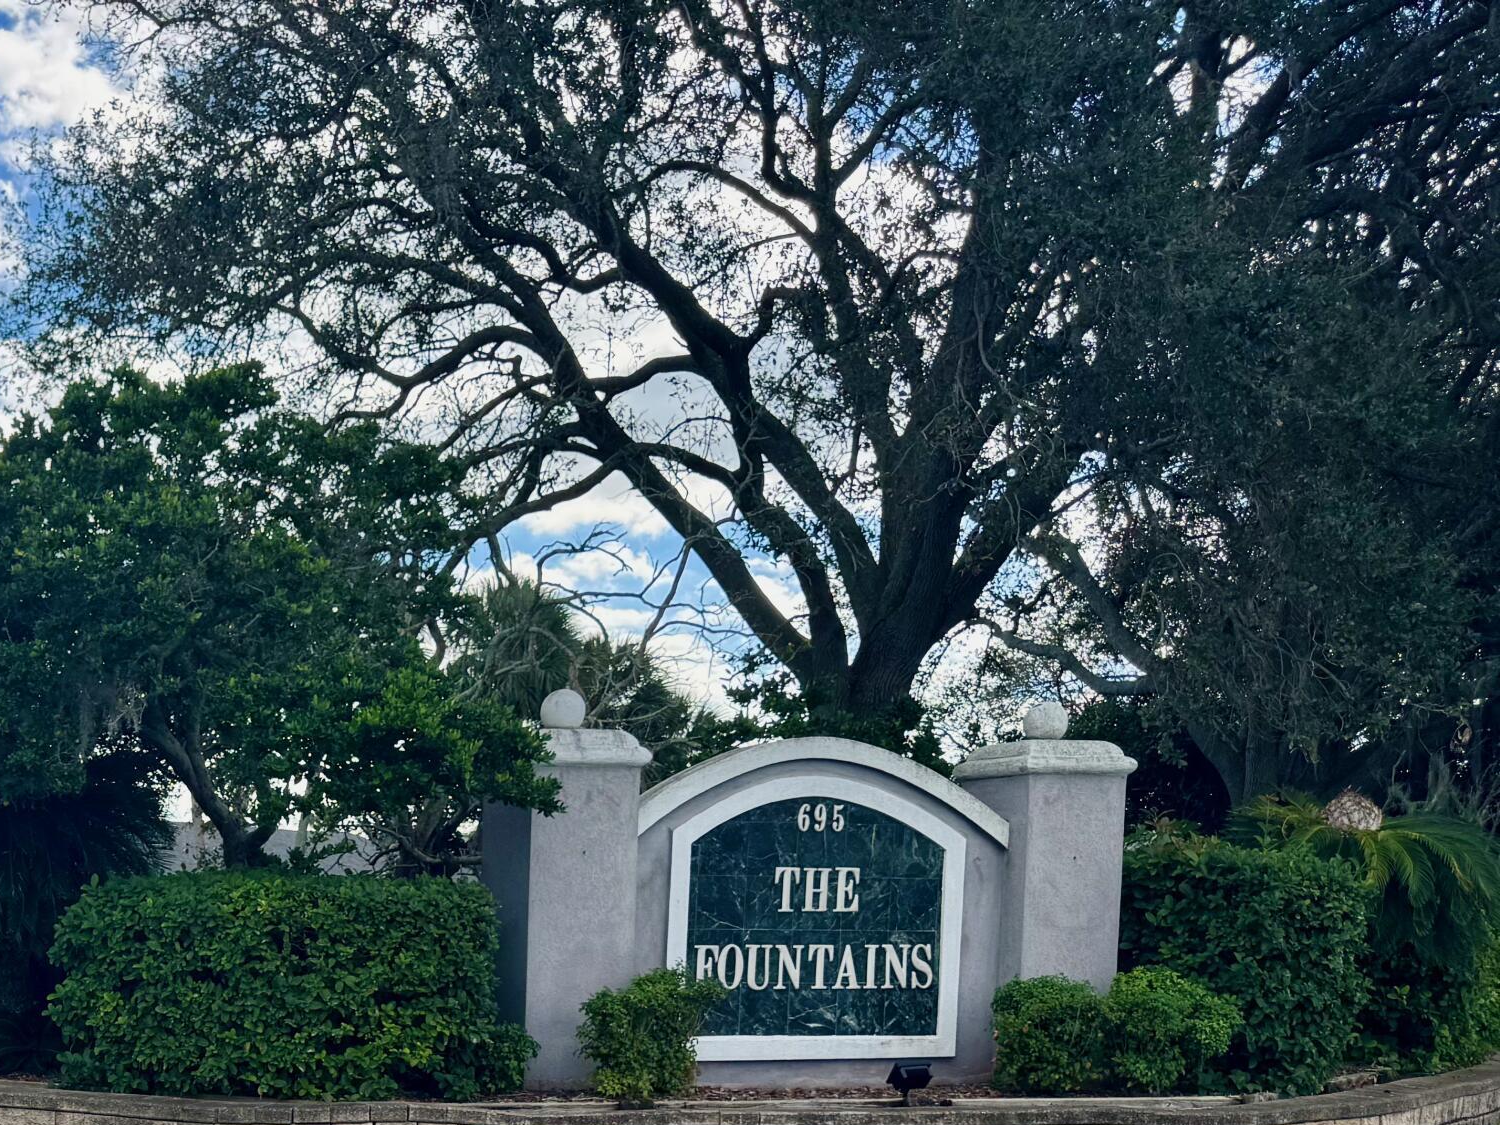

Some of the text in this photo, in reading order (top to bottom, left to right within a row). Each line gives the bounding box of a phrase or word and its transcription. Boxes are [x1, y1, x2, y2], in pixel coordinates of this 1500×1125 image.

[797, 803, 845, 833] 695
[774, 866, 860, 913] THE
[694, 942, 934, 991] FOUNTAINS
